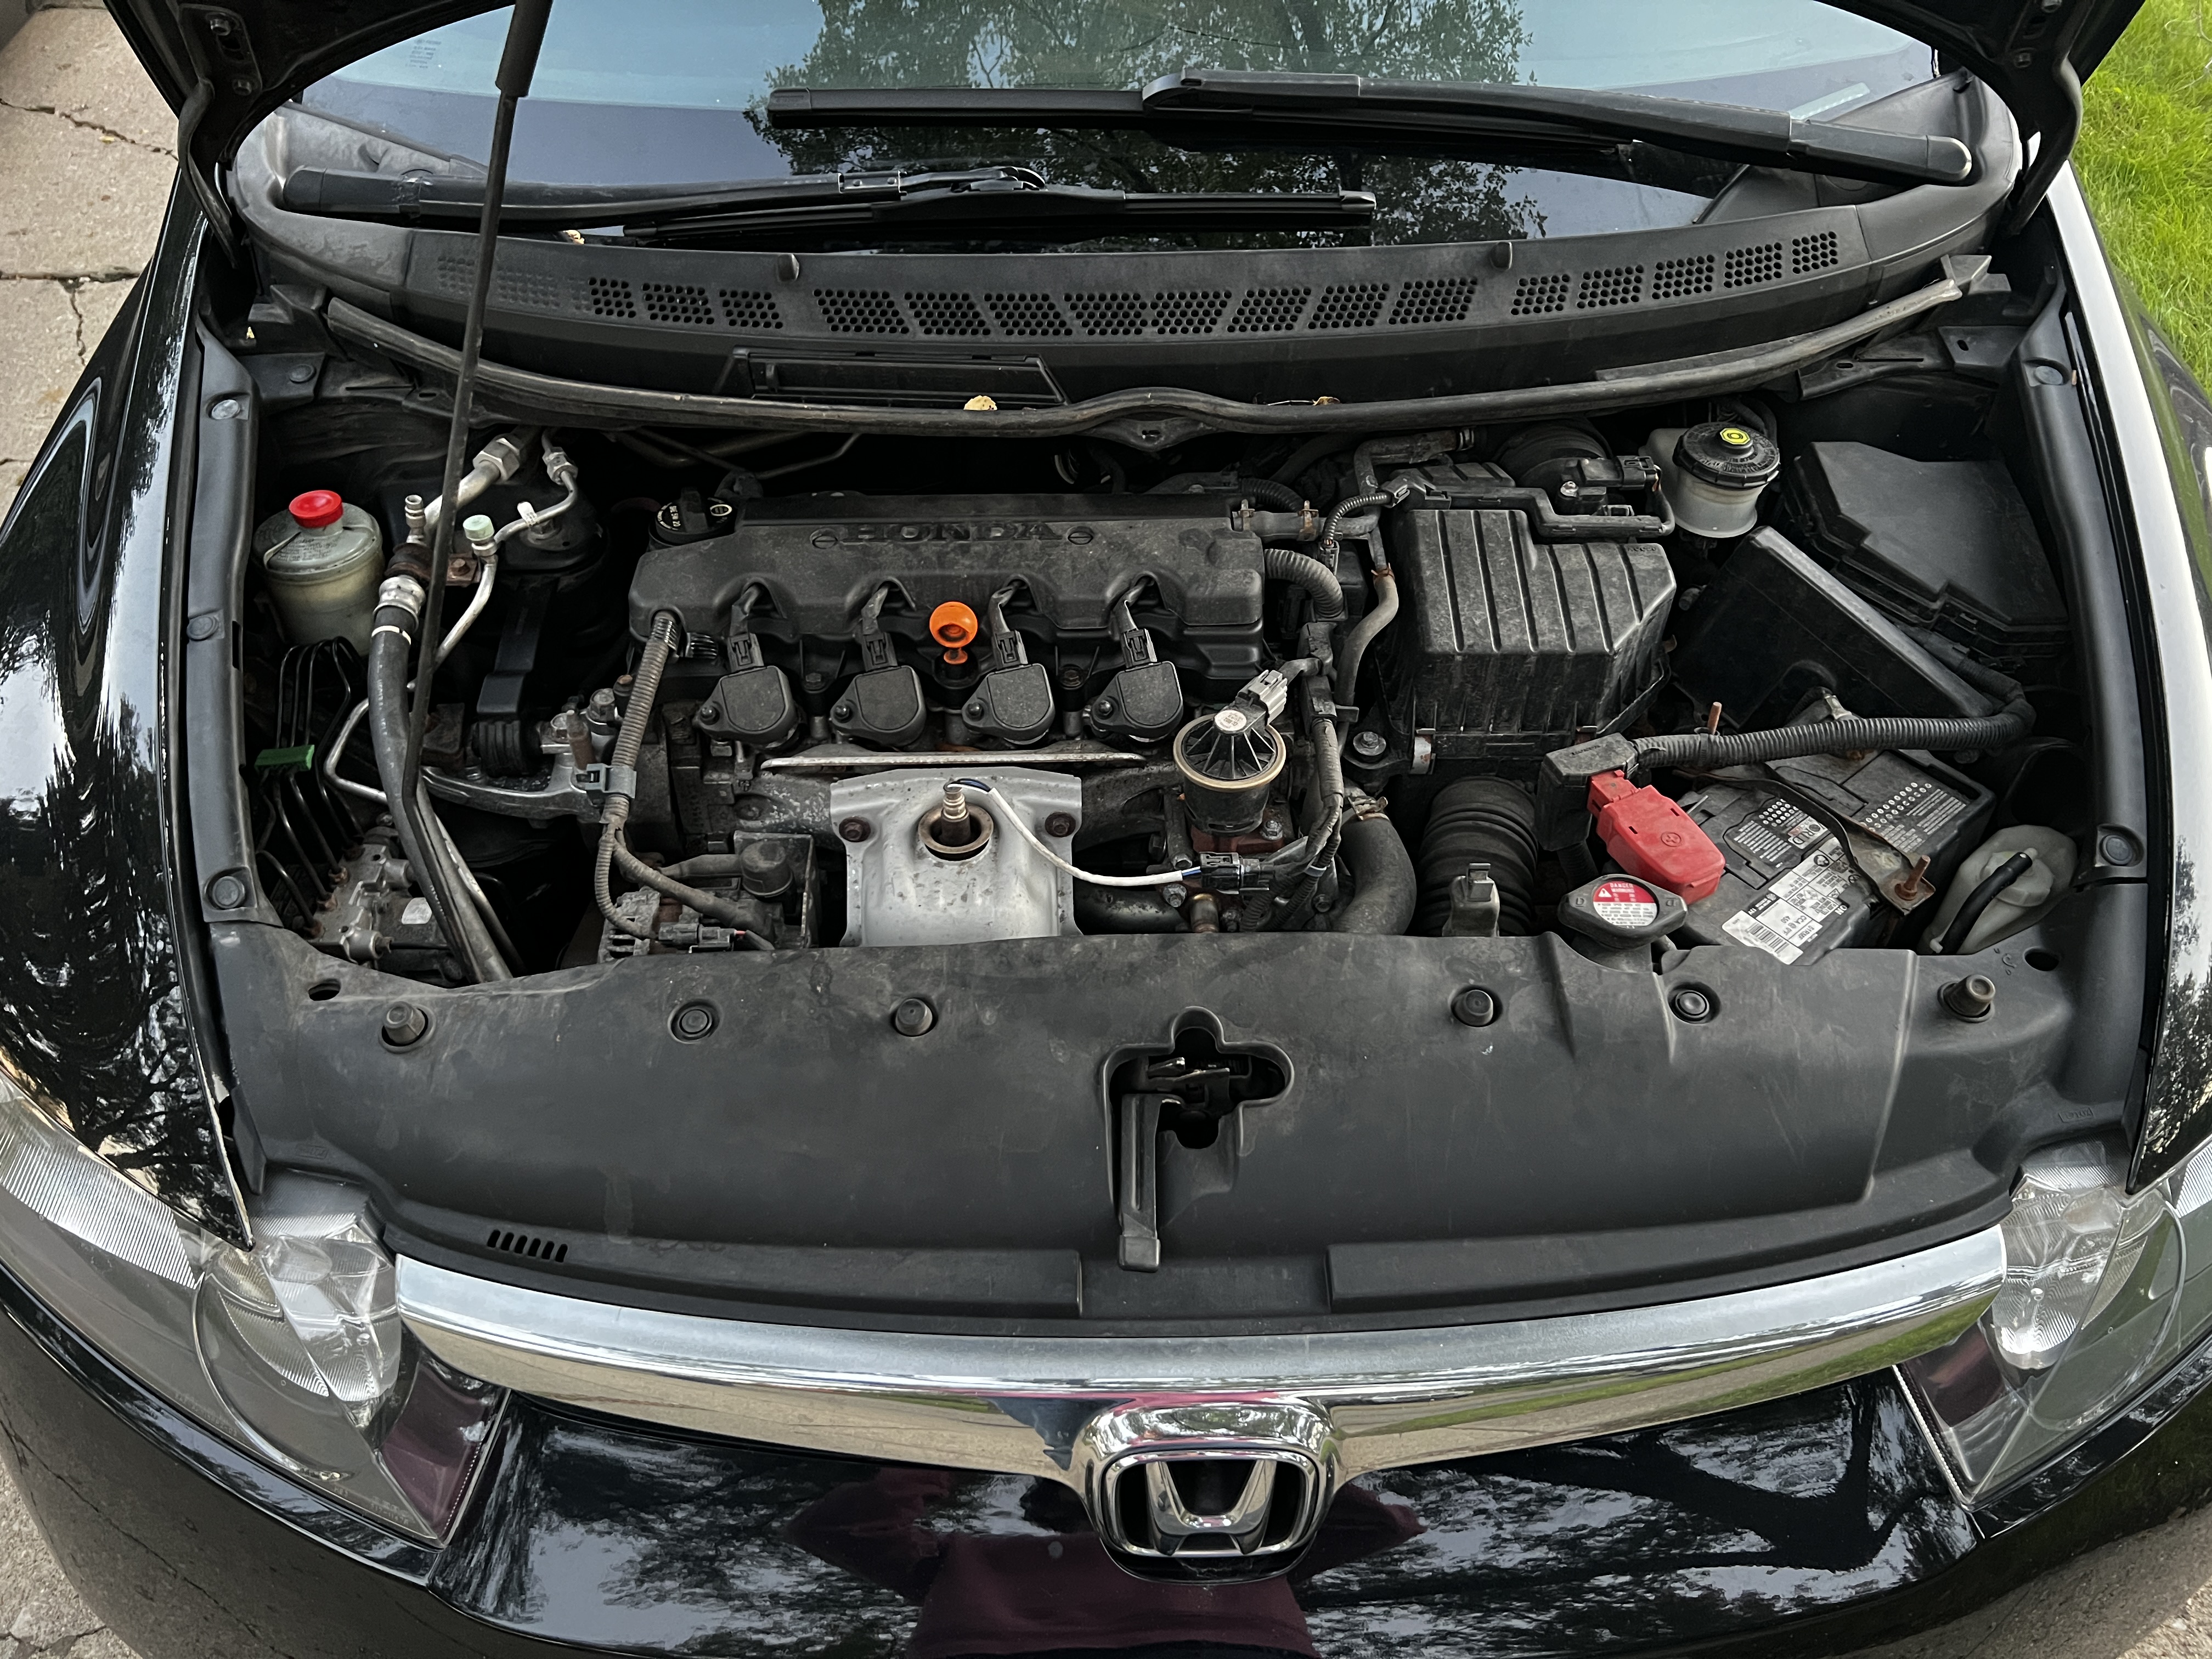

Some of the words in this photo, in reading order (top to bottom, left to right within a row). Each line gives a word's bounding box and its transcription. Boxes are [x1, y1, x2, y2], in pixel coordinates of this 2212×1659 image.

[841, 522, 1063, 543] HONDA
[1792, 822, 1825, 845] ORLD
[1794, 915, 1807, 924] CCA
